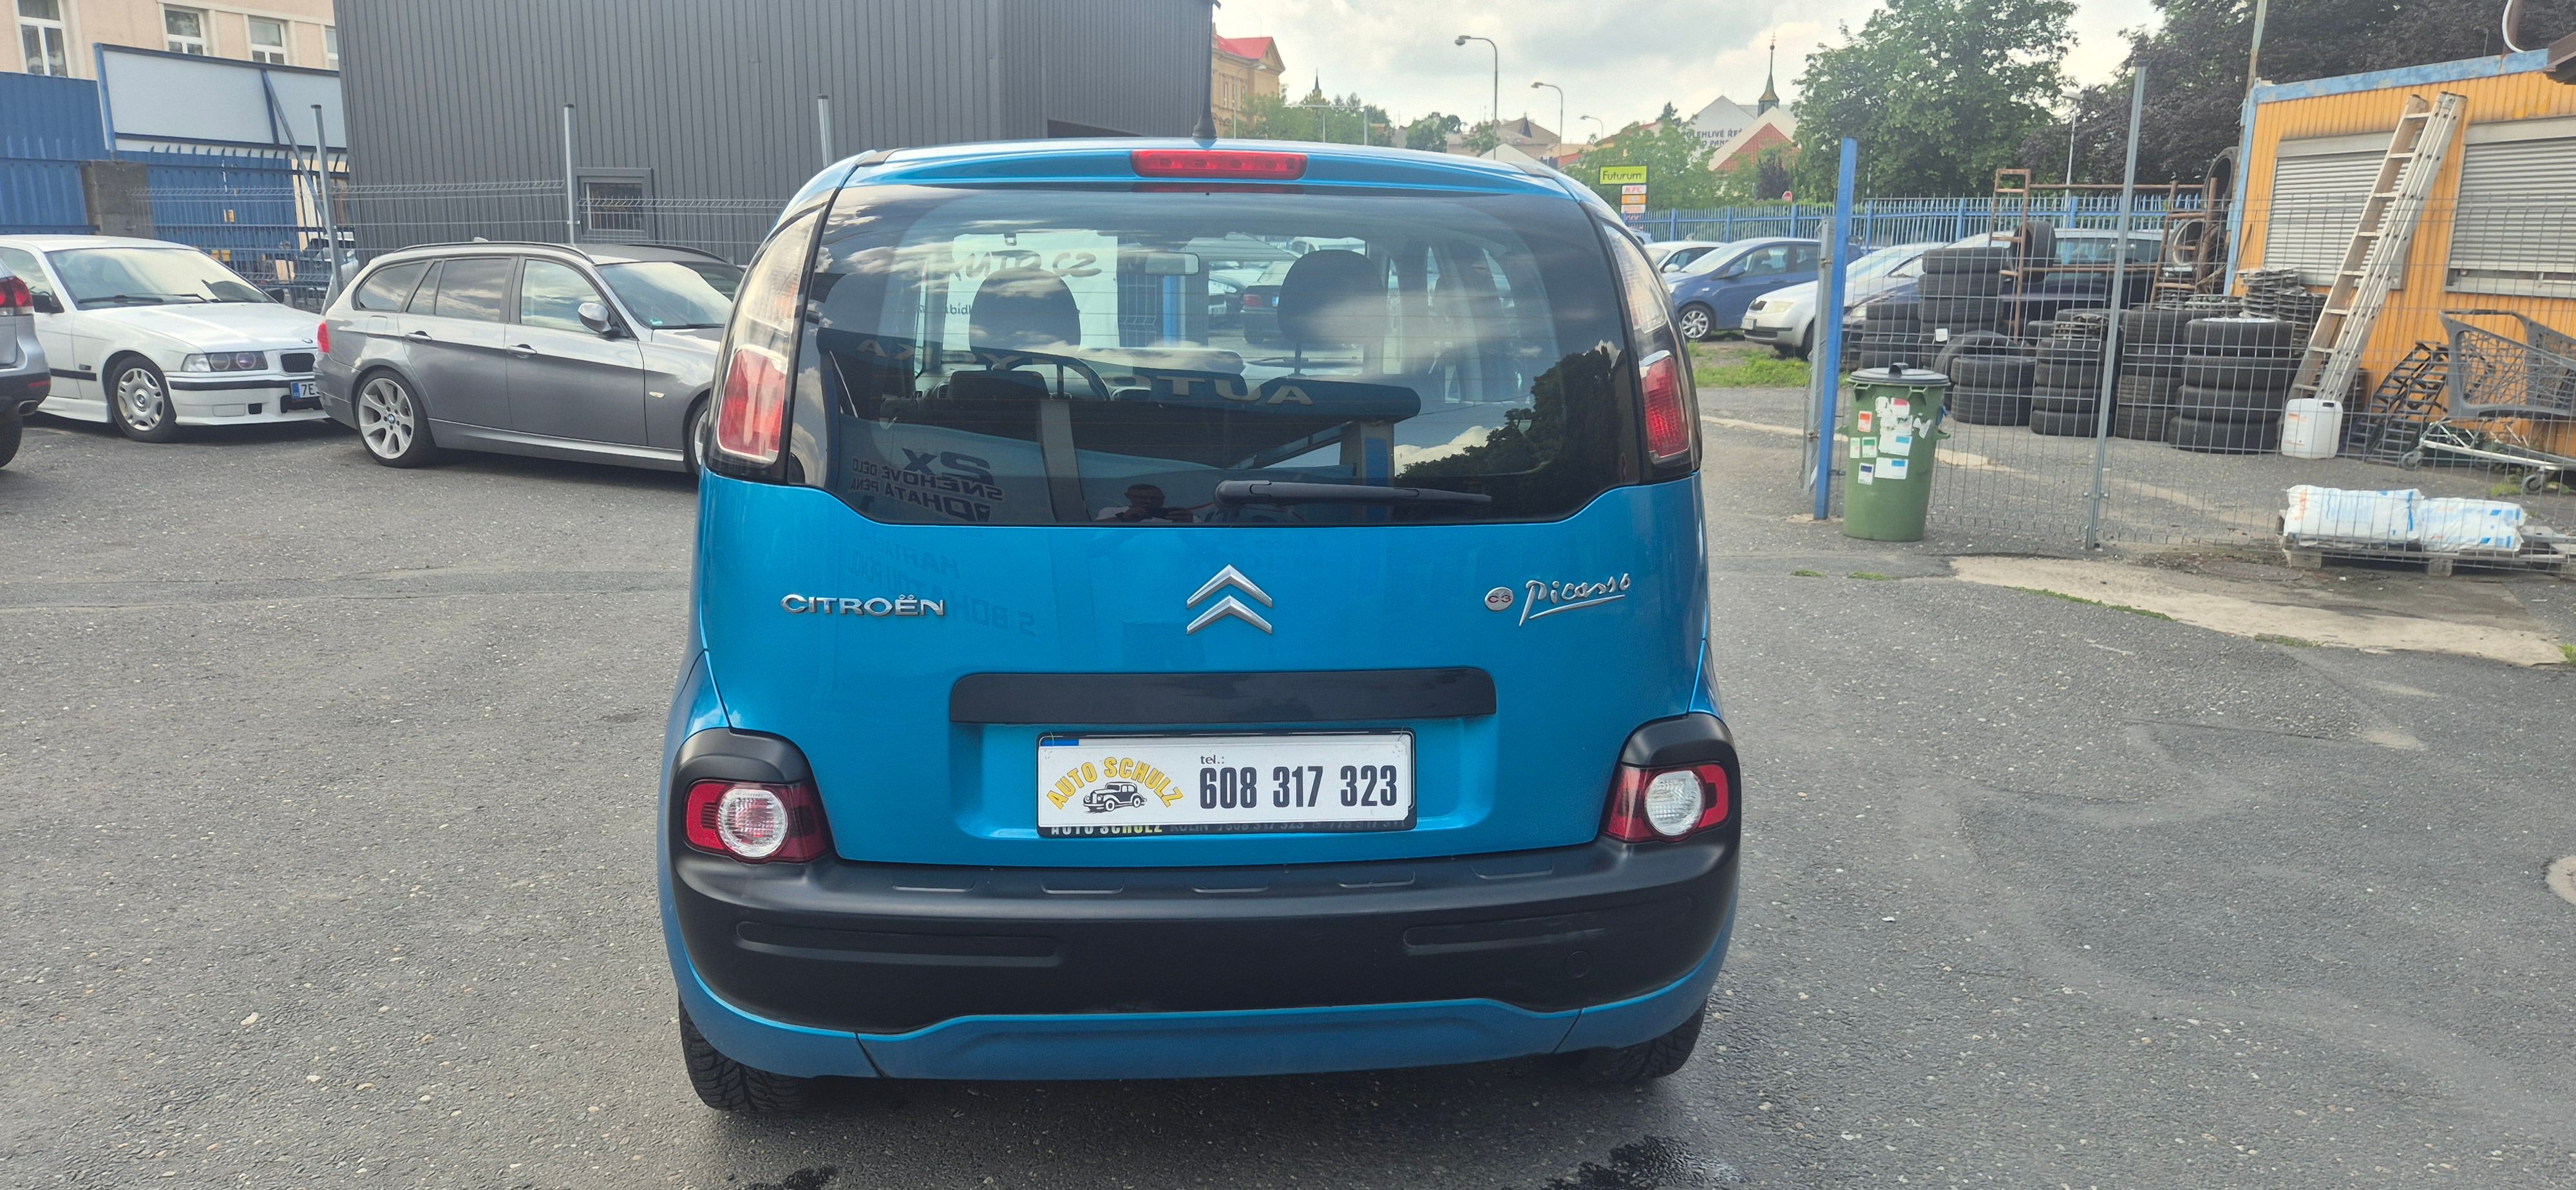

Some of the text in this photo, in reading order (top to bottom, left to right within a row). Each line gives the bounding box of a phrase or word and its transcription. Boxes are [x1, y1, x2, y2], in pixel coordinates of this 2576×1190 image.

[1602, 171, 1642, 181] Futurum
[781, 593, 945, 616] CITROËN
[1488, 572, 1632, 627] C3 Picasso
[1200, 755, 1224, 764] tel.:
[1046, 757, 1184, 810] AUTO SCHULZ
[1200, 765, 1397, 809] 608 317 323
